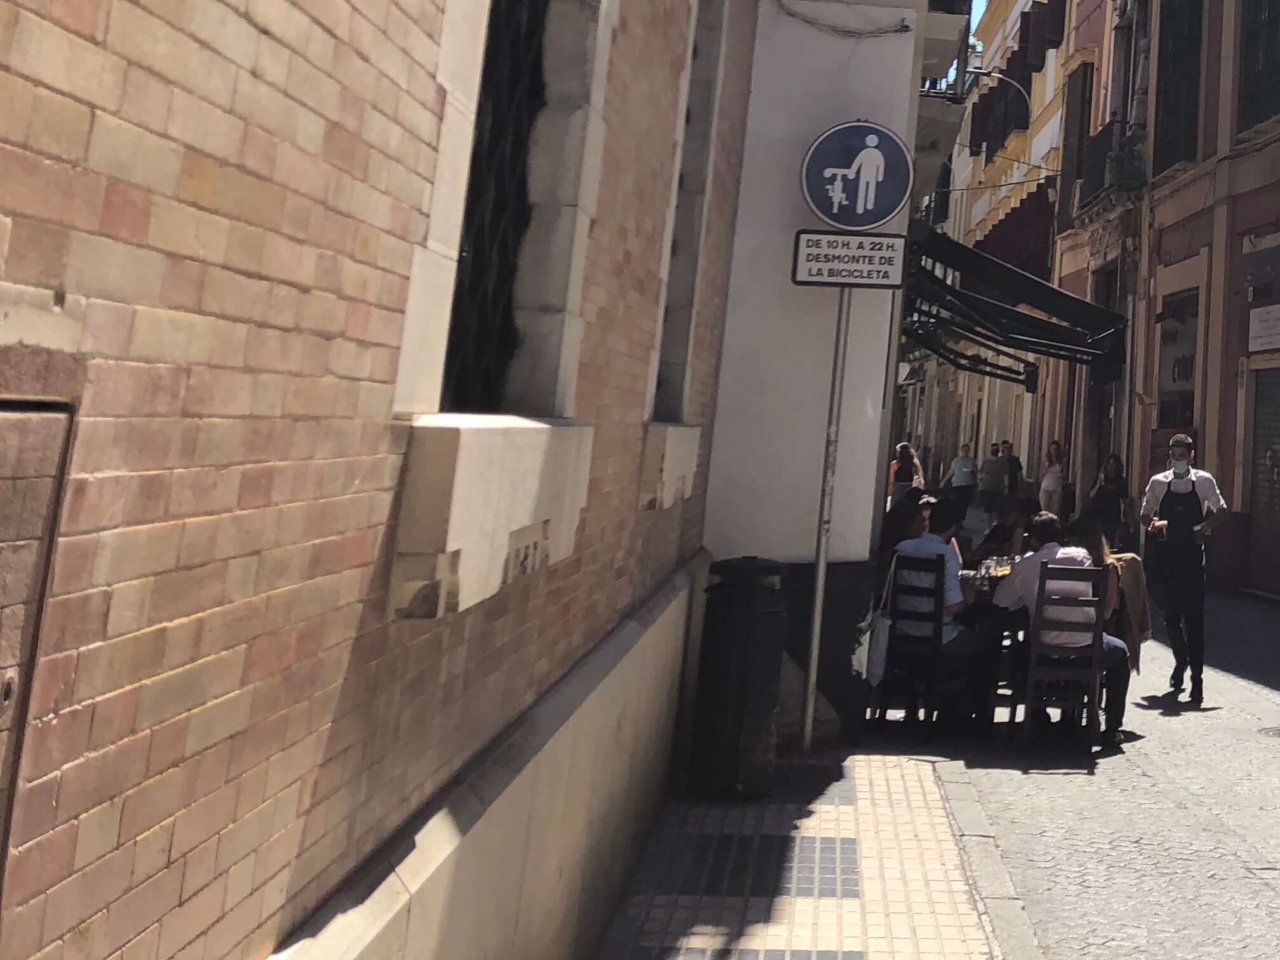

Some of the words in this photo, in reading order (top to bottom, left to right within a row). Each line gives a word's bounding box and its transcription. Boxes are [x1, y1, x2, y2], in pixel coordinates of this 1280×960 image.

[806, 239, 822, 249] DE
[826, 240, 839, 250] 10
[856, 241, 865, 251] A
[869, 242, 884, 251] 22
[806, 253, 876, 266] DESMONTE
[878, 256, 895, 266] DE
[808, 268, 824, 277] LA
[827, 268, 890, 280] BICICLETA
